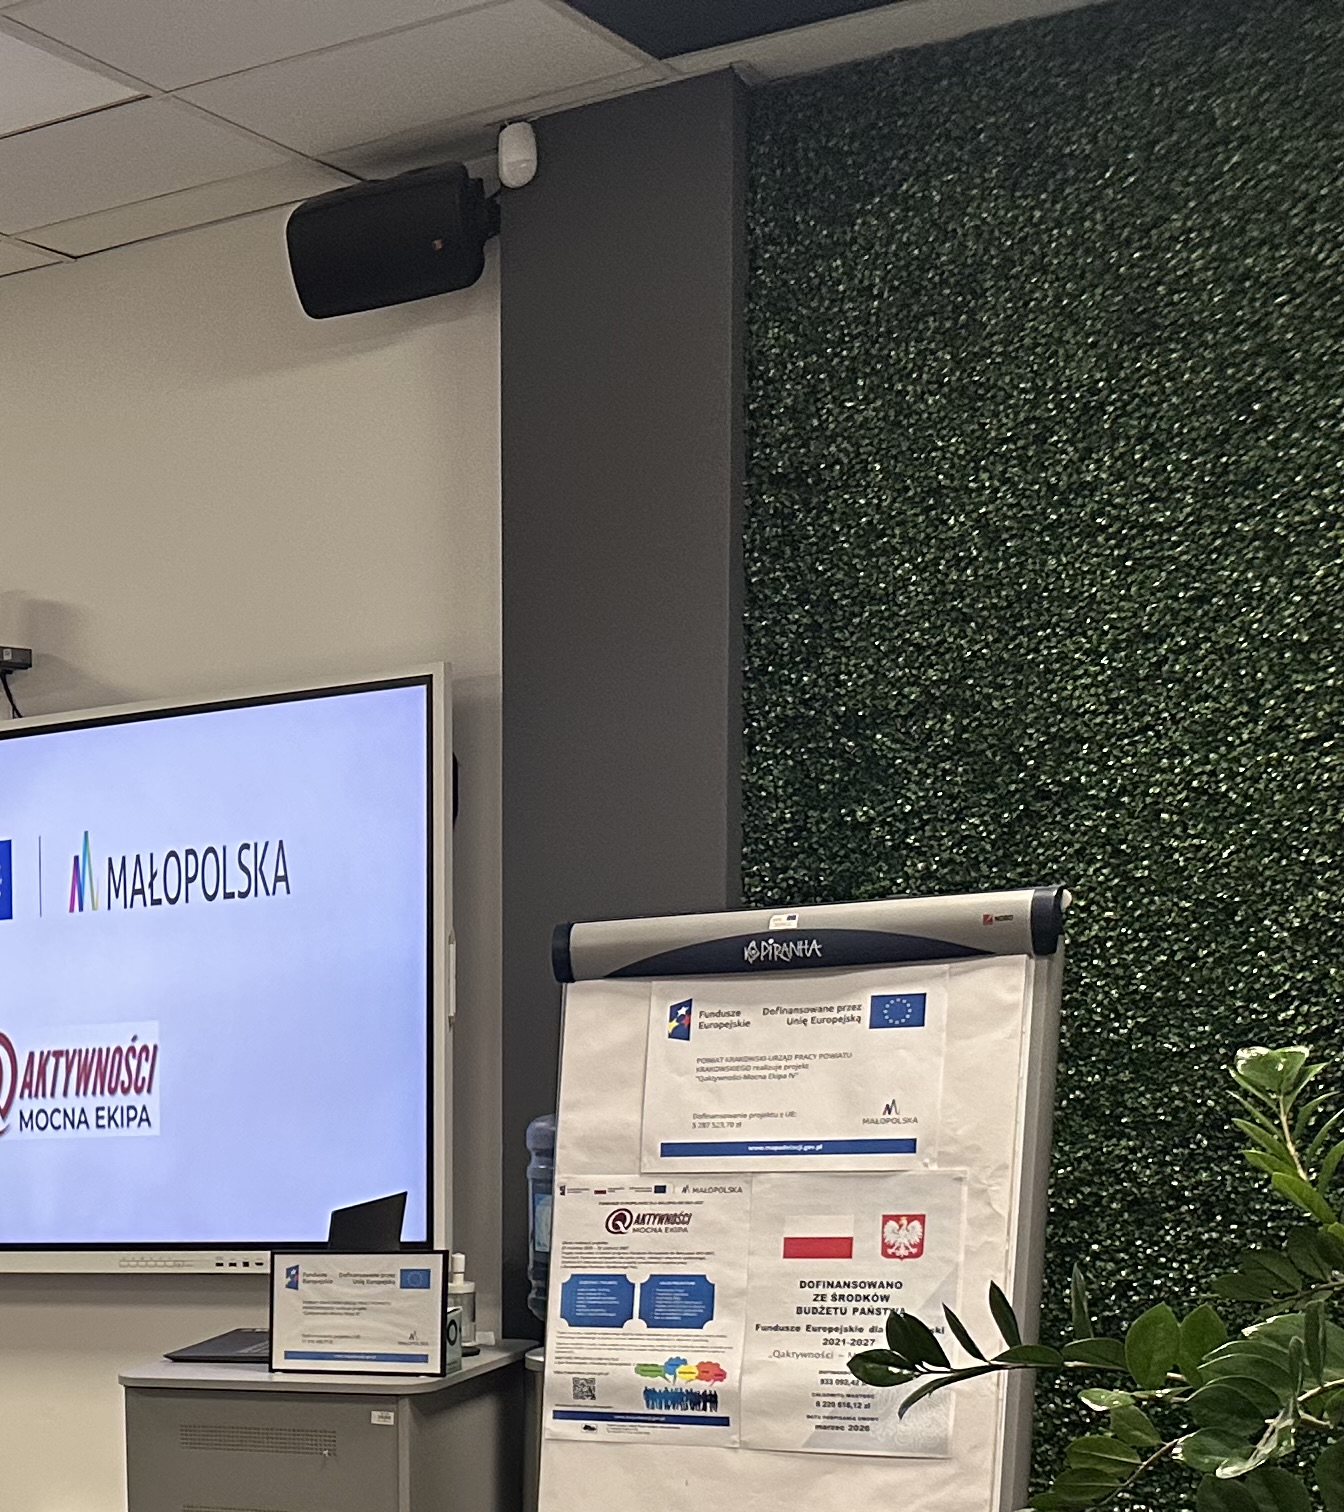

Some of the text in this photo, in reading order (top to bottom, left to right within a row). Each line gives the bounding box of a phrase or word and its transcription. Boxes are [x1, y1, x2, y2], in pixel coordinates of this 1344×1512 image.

[107, 839, 291, 911] MAŁOPOLSKA
[699, 1009, 742, 1019] Fundusze
[762, 1003, 863, 1017] Dofinansowane przez
[698, 1019, 751, 1030] Europejskie
[787, 1013, 862, 1027] Unię Europejską
[19, 1104, 152, 1132] MOCNA EKIPA
[862, 1116, 919, 1125] MAŁOPOLSKA
[691, 1186, 744, 1195] MAŁOPOLSKA
[799, 1280, 904, 1290] DOFINANSOWANO
[812, 1291, 891, 1303] ZE ŚRODKÓW
[796, 1305, 848, 1316] BUDŻETU
[755, 1323, 884, 1335] Fundusze Europejskie dla
[821, 1337, 876, 1347] 2021-2027
